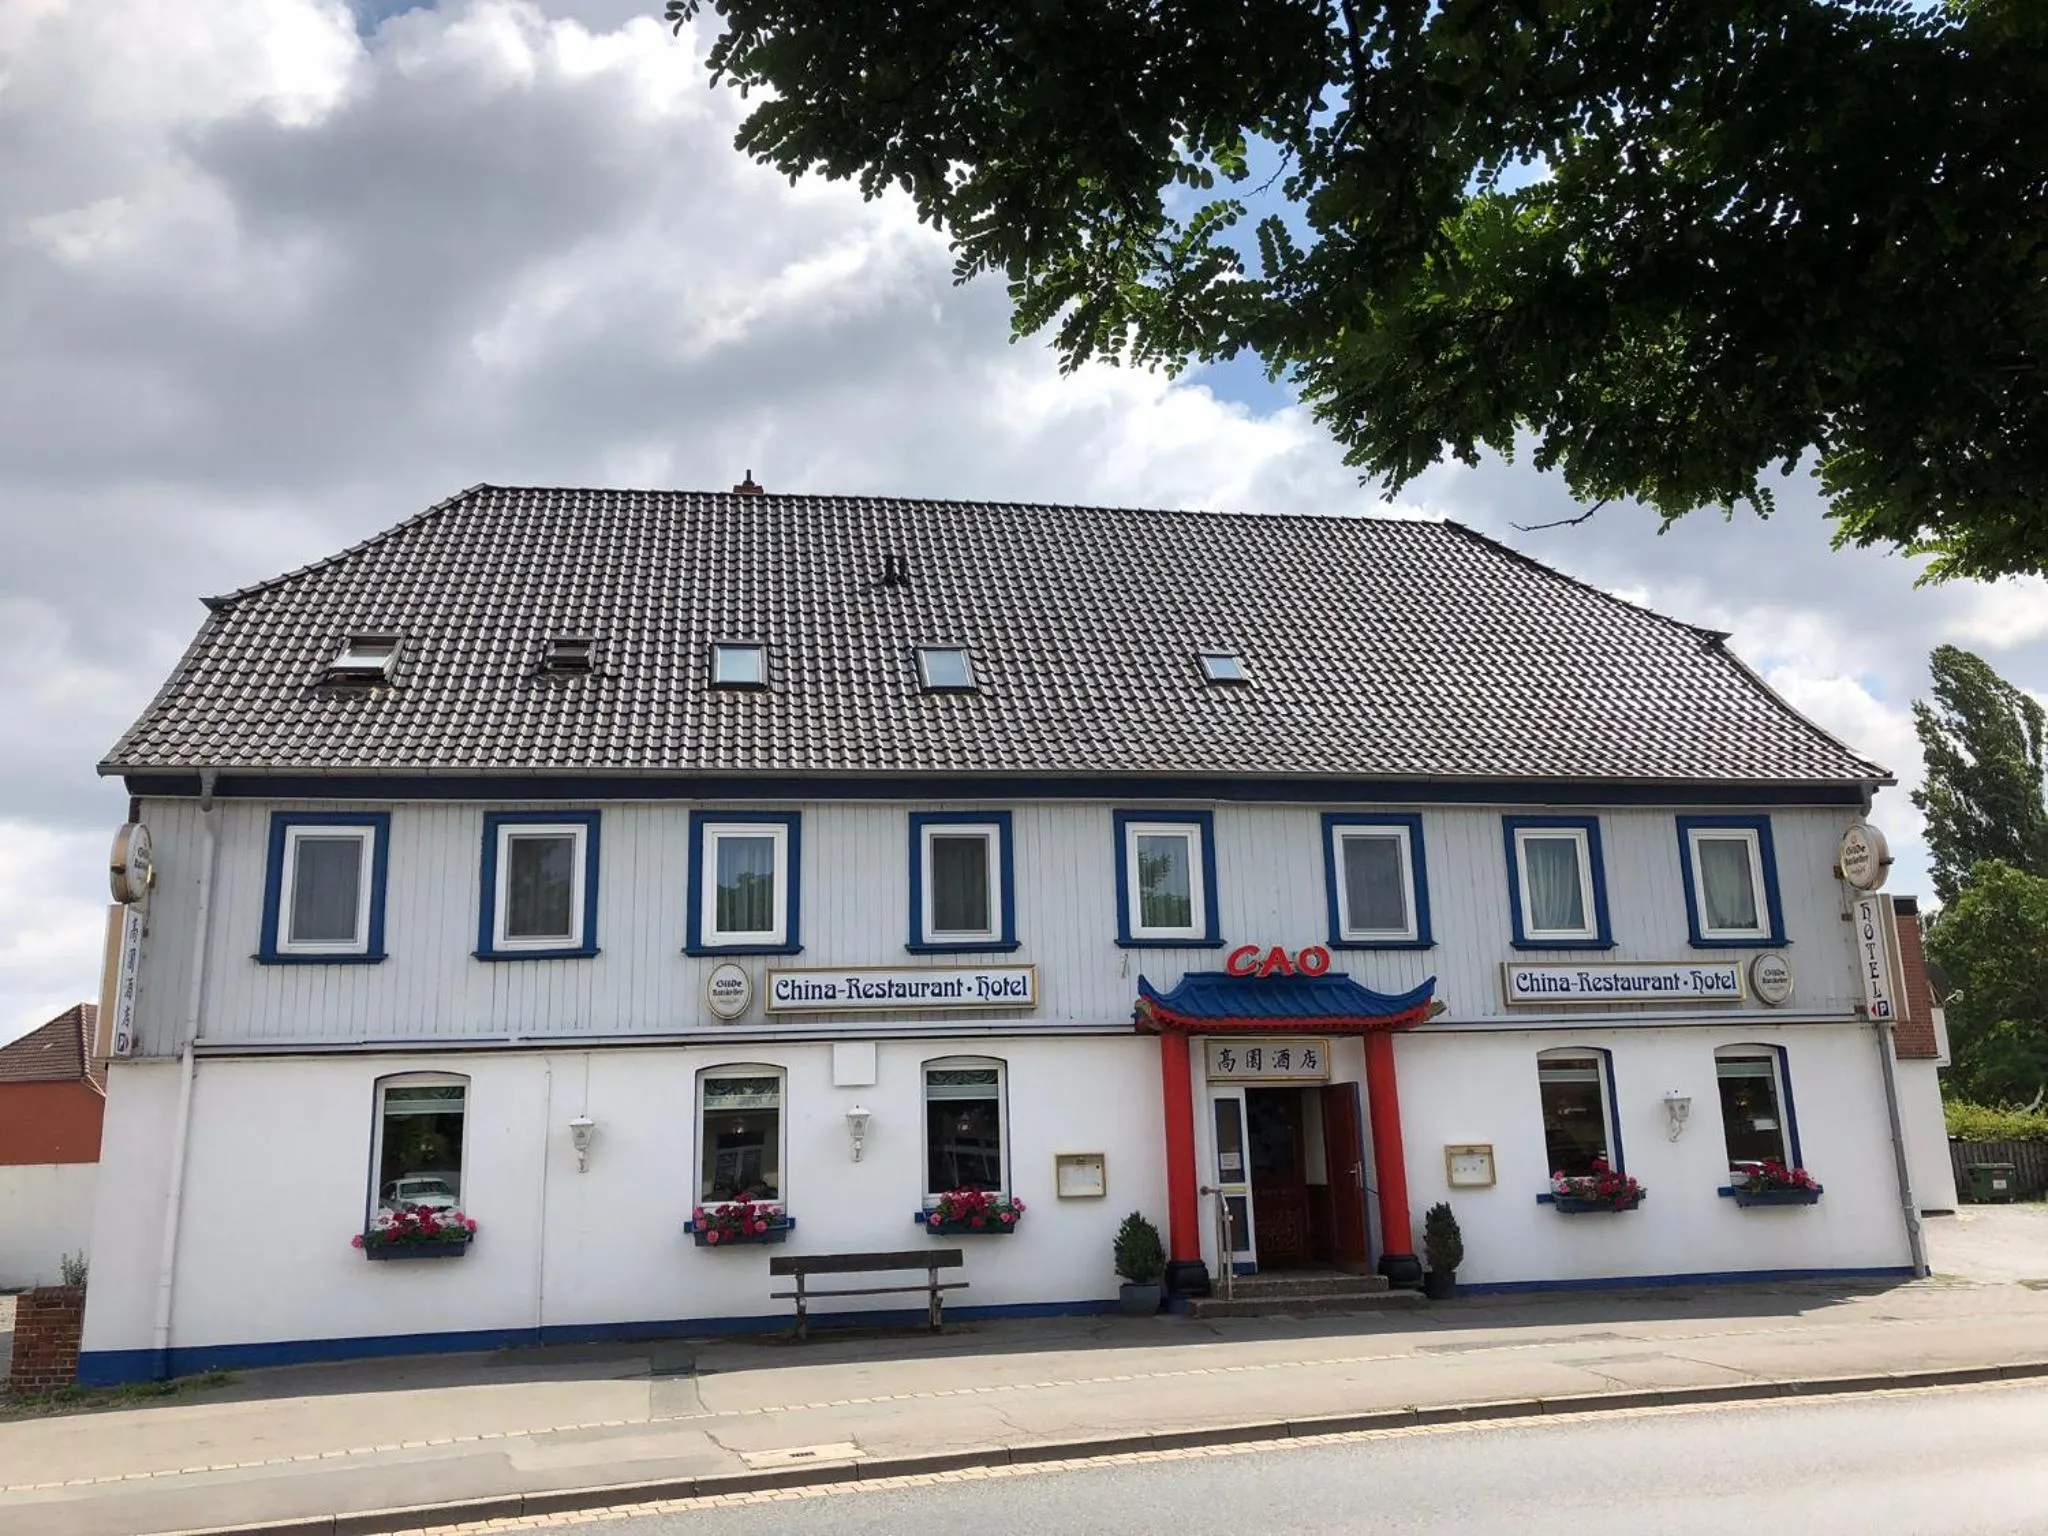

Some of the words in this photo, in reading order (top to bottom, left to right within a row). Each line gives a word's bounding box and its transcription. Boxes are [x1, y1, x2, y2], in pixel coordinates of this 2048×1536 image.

[1226, 944, 1331, 978] CAO
[775, 977, 963, 1000] China-Restaurant
[975, 975, 1028, 1001] Hotel
[1516, 971, 1680, 993] China-Restaurant
[1689, 970, 1737, 994] Hotel
